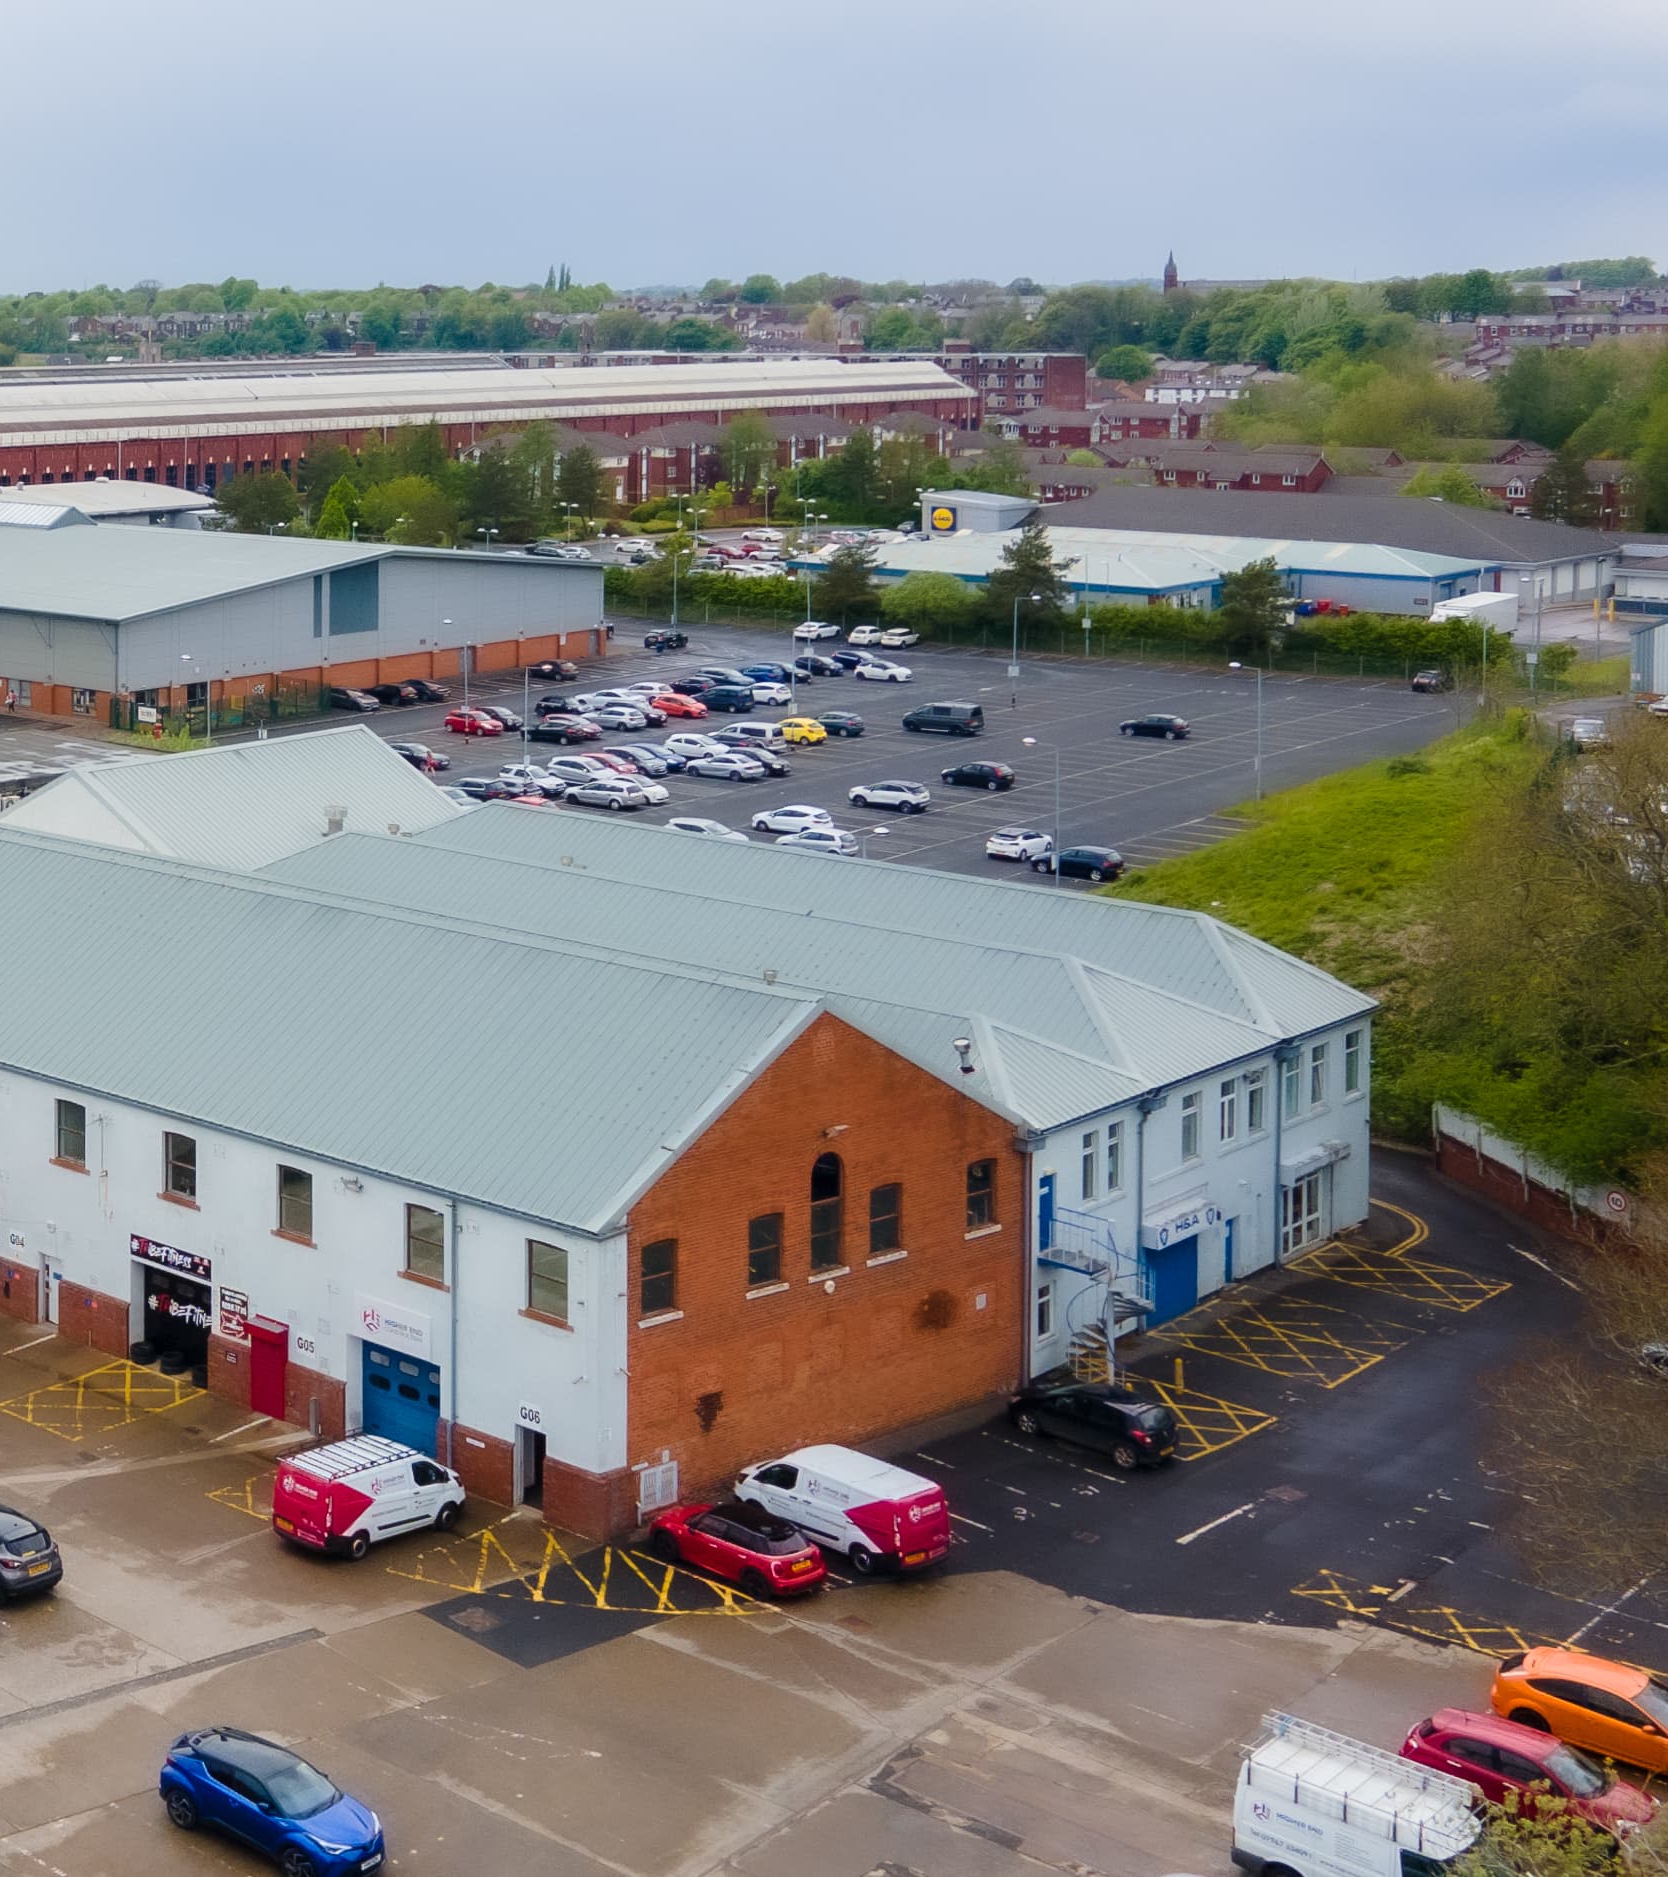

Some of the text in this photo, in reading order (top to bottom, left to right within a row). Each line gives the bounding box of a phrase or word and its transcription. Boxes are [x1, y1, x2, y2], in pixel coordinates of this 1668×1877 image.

[10, 1233, 25, 1247] G04
[296, 1336, 315, 1354] G05
[519, 1406, 541, 1424] G06
